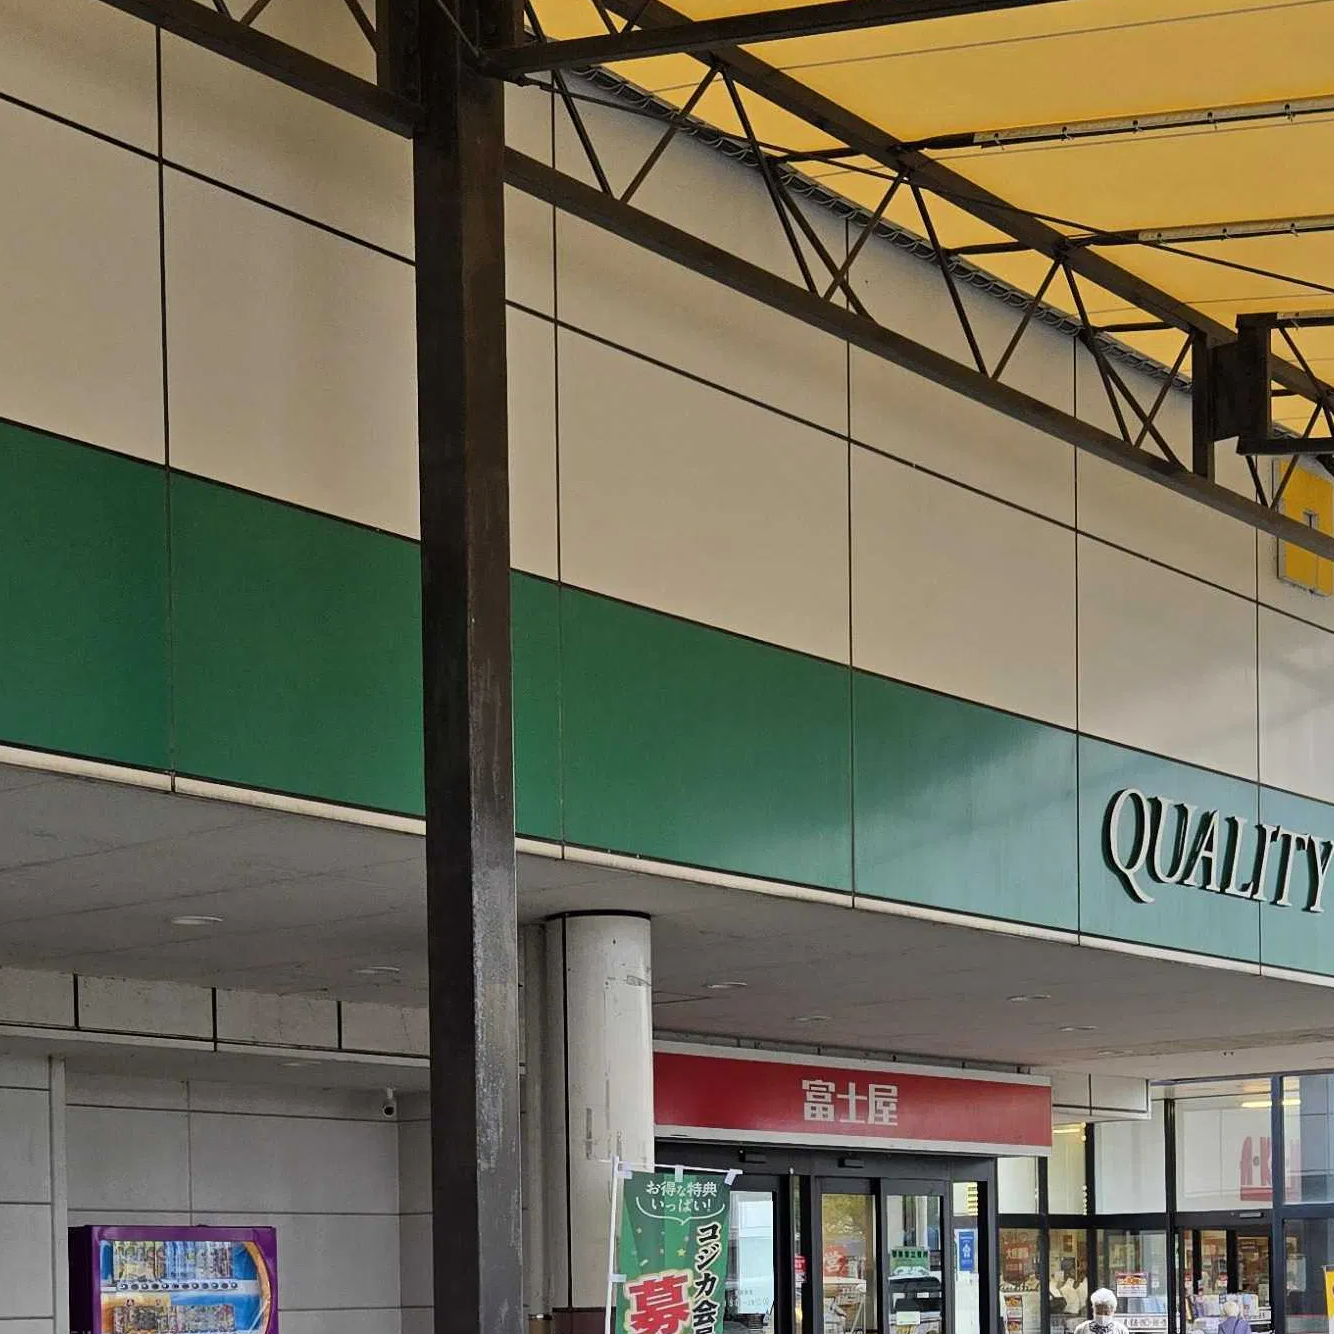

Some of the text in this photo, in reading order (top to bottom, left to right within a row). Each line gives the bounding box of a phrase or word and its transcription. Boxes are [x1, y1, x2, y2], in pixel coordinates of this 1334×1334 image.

[801, 1079, 898, 1126] 富士屋
[646, 1180, 718, 1198] お得な特典
